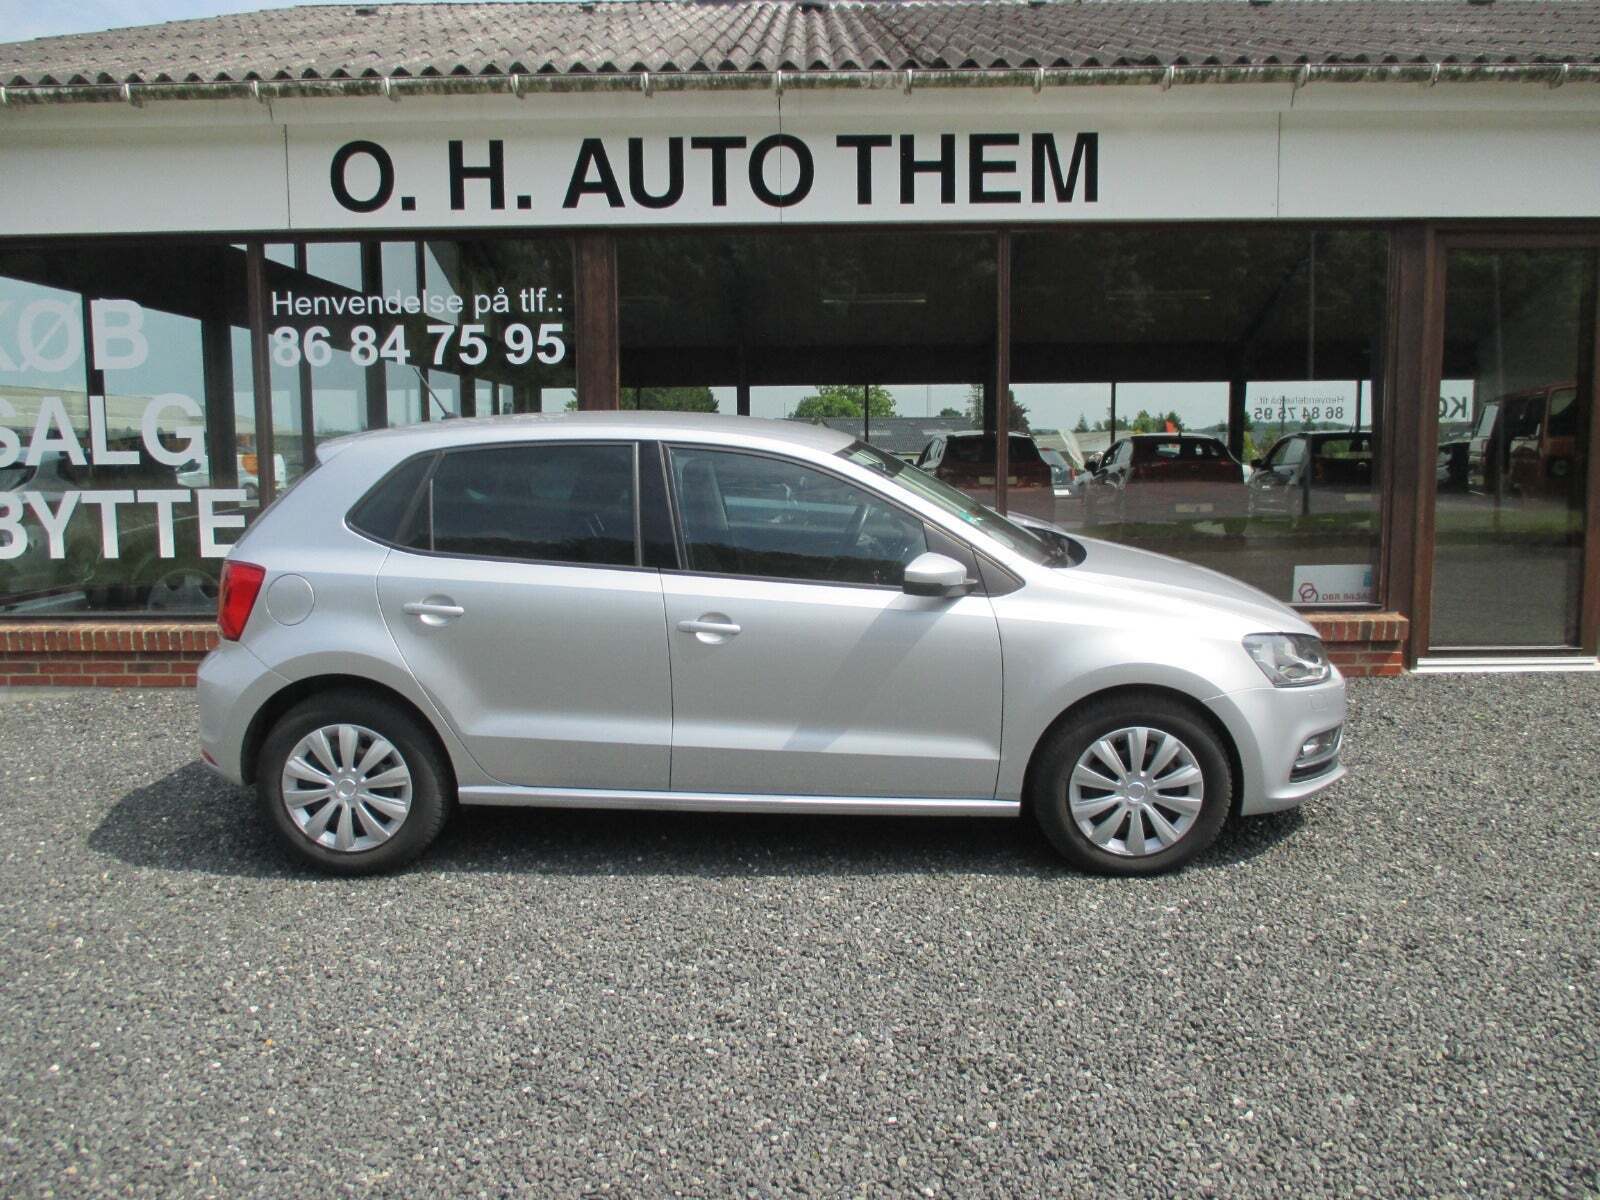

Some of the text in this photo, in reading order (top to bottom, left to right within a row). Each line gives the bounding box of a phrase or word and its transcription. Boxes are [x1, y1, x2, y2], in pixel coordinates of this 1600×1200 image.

[331, 132, 1098, 213] O. H. AUTO THEM
[272, 287, 562, 319] Henvendelse på tlf.:
[273, 323, 565, 367] 86 84 75 95
